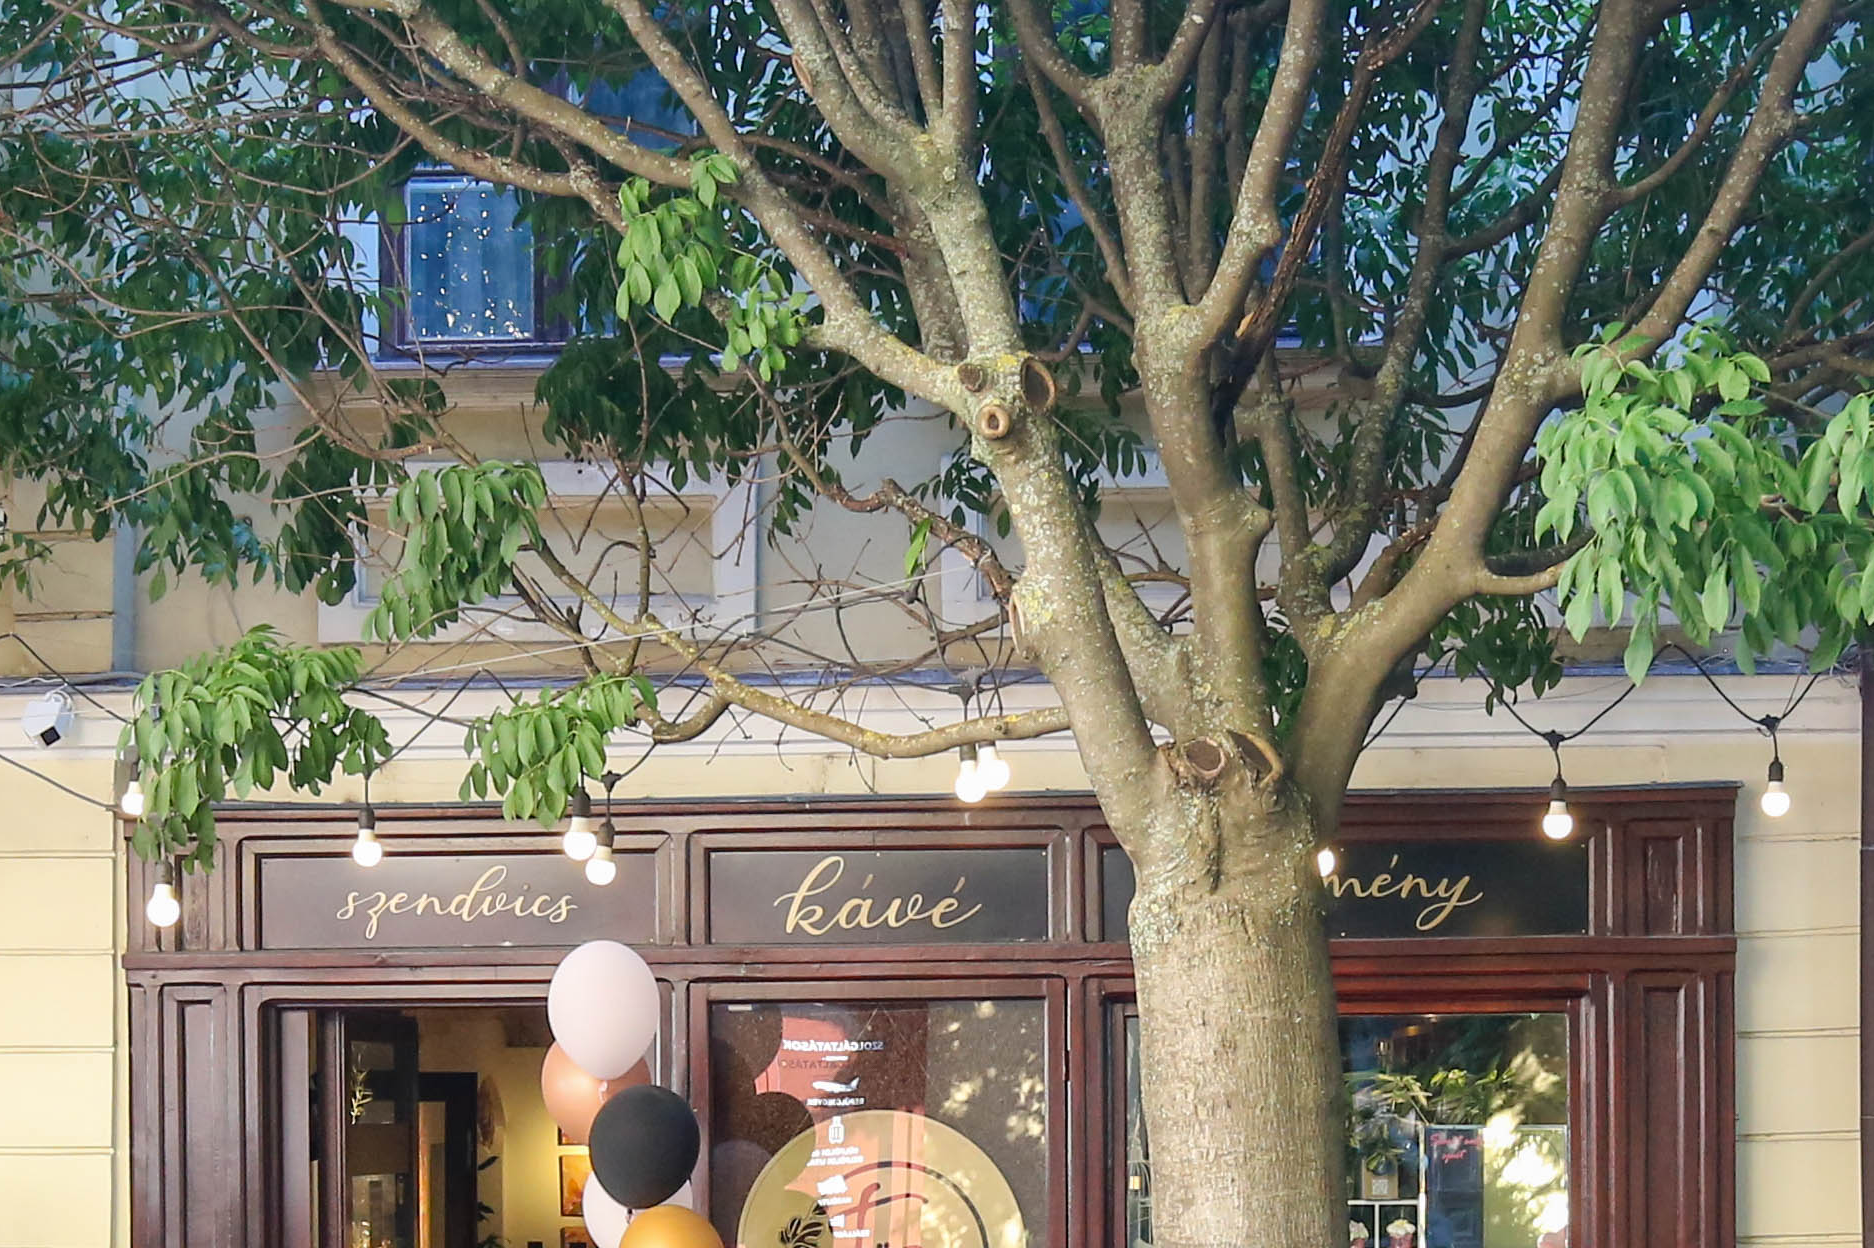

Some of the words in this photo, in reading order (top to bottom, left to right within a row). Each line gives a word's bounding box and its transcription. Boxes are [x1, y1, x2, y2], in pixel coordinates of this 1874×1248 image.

[336, 865, 579, 940] szendvics
[772, 855, 983, 936] kávé
[1320, 853, 1484, 931] mény
